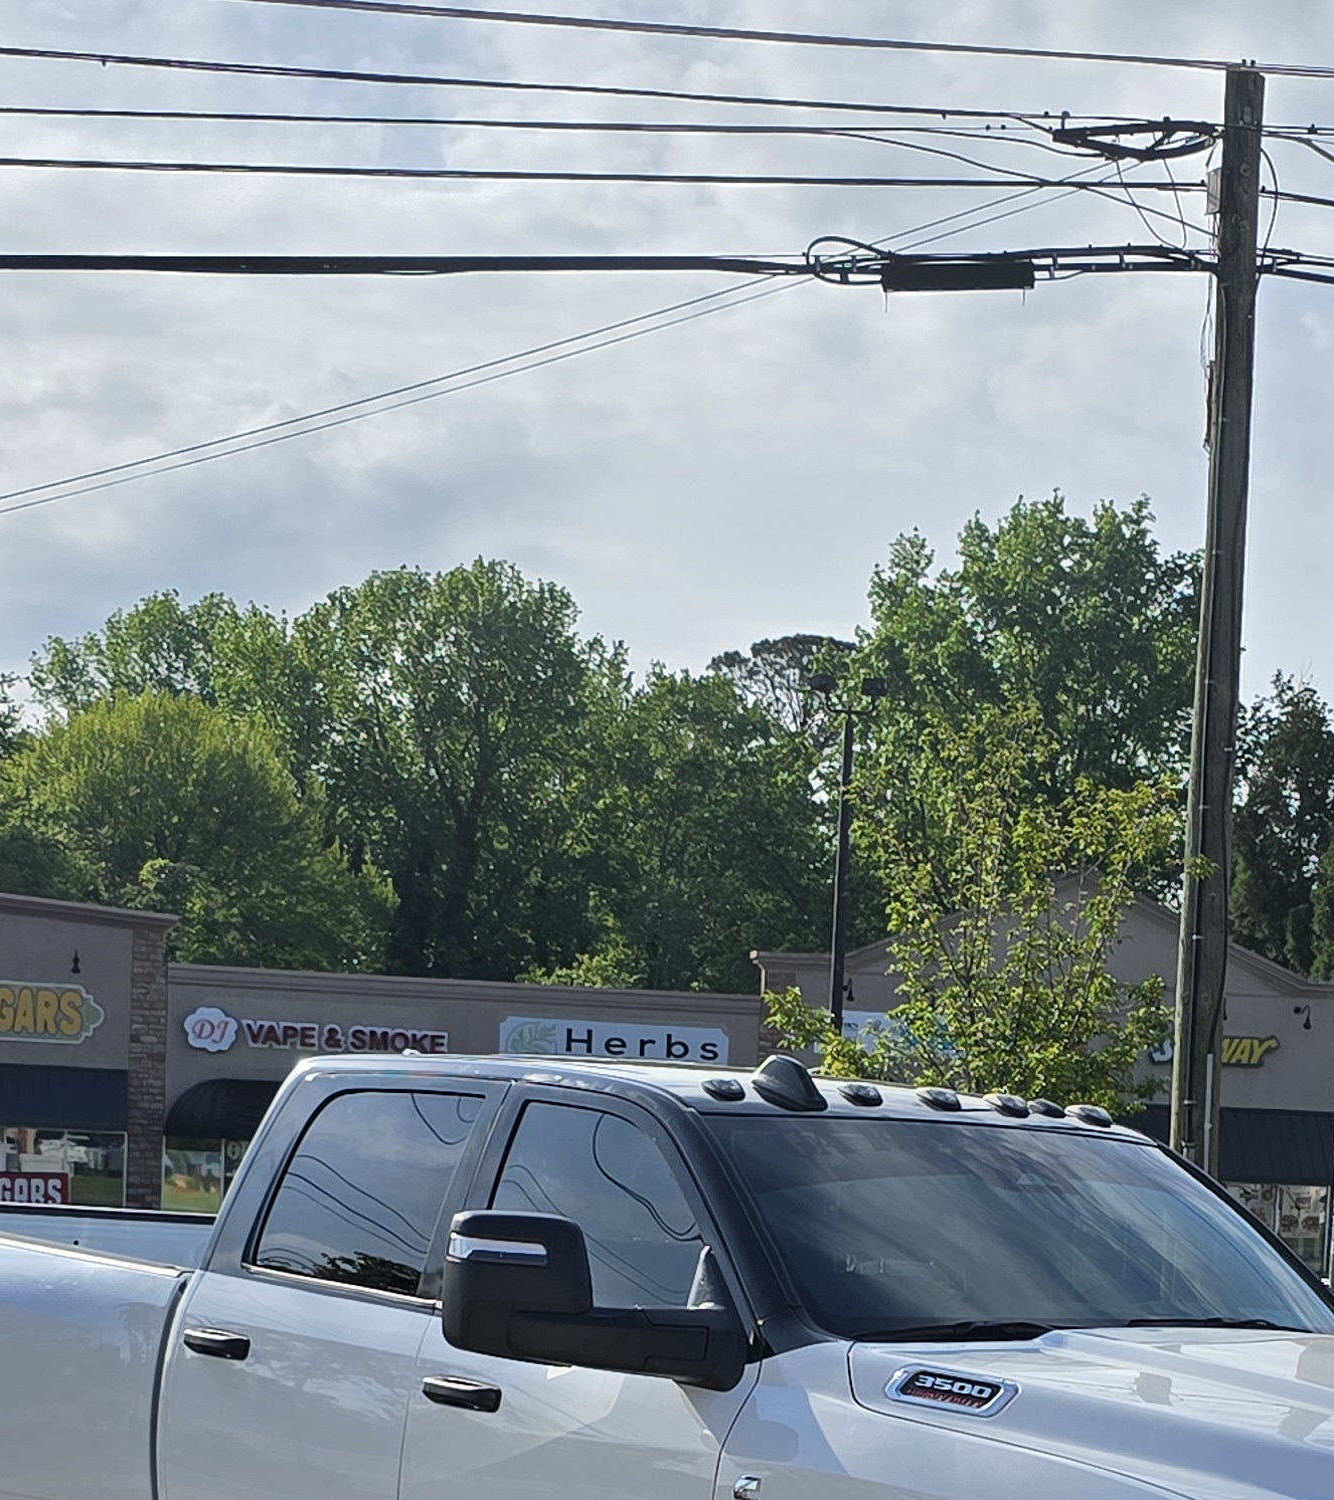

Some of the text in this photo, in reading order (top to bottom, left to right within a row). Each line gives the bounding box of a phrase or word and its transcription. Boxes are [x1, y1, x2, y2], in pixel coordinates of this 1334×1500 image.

[191, 1018, 446, 1052] DJ VAPE & SMOKE
[565, 1028, 720, 1061] Herbs
[1152, 1037, 1278, 1065] SWAY
[914, 1374, 992, 1398] 3500
